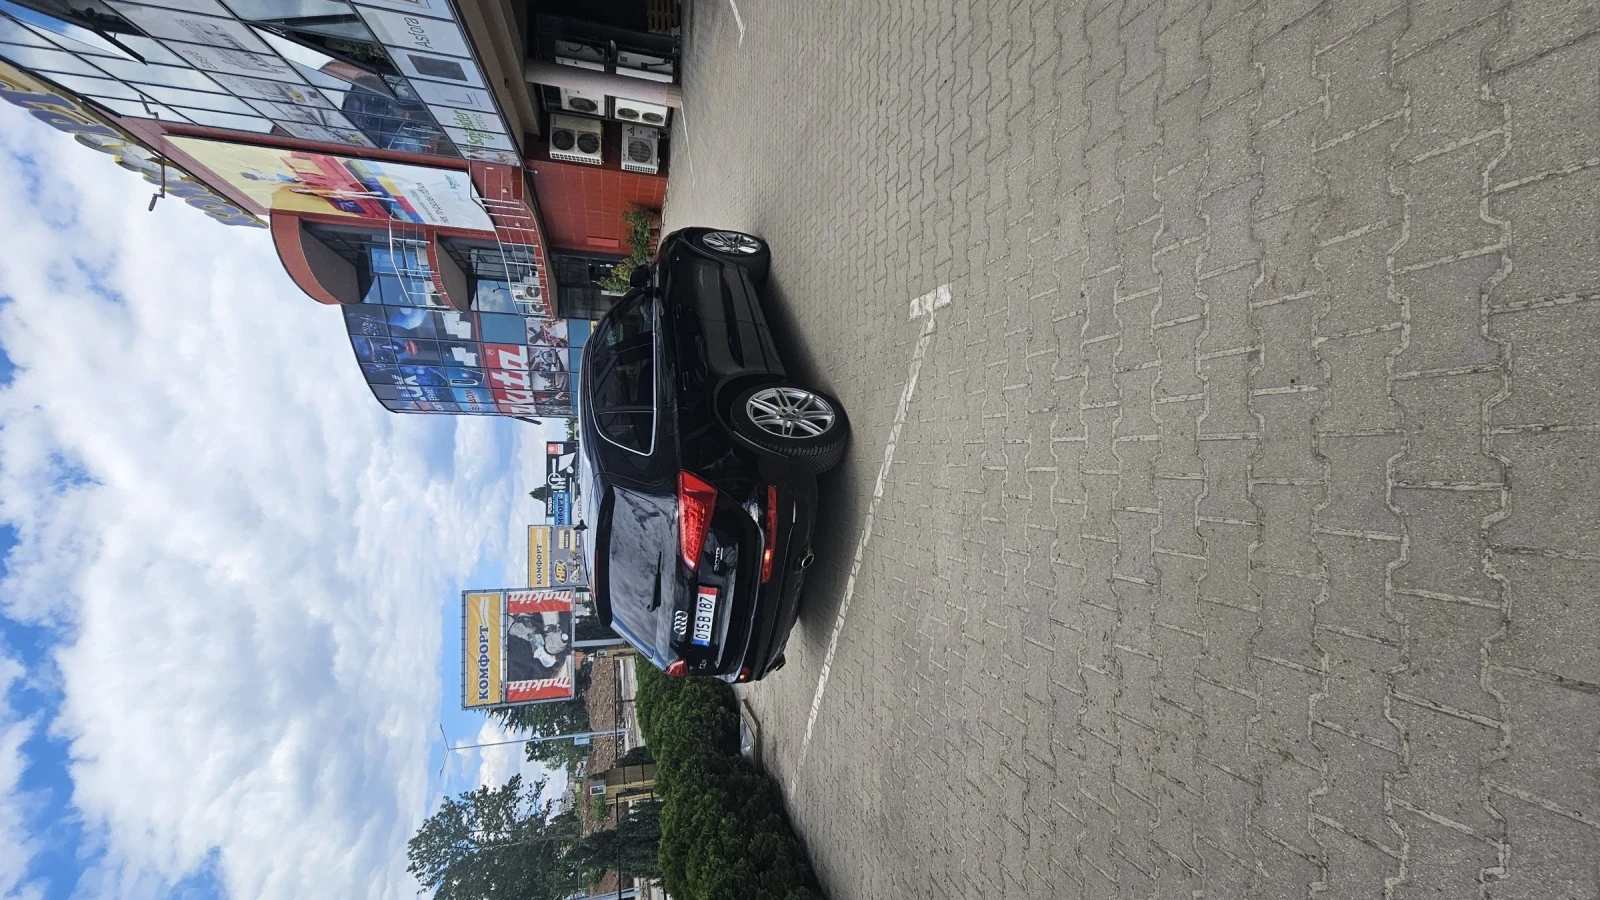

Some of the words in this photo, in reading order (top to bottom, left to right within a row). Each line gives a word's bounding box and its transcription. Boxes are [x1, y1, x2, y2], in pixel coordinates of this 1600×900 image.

[403, 17, 433, 49] Asfora
[491, 345, 537, 414] akita
[535, 544, 543, 584] КОМФОРТ
[556, 561, 566, 581] HPX
[507, 591, 572, 605] makita
[478, 625, 490, 701] КОМФОРТ
[507, 677, 571, 692] makita
